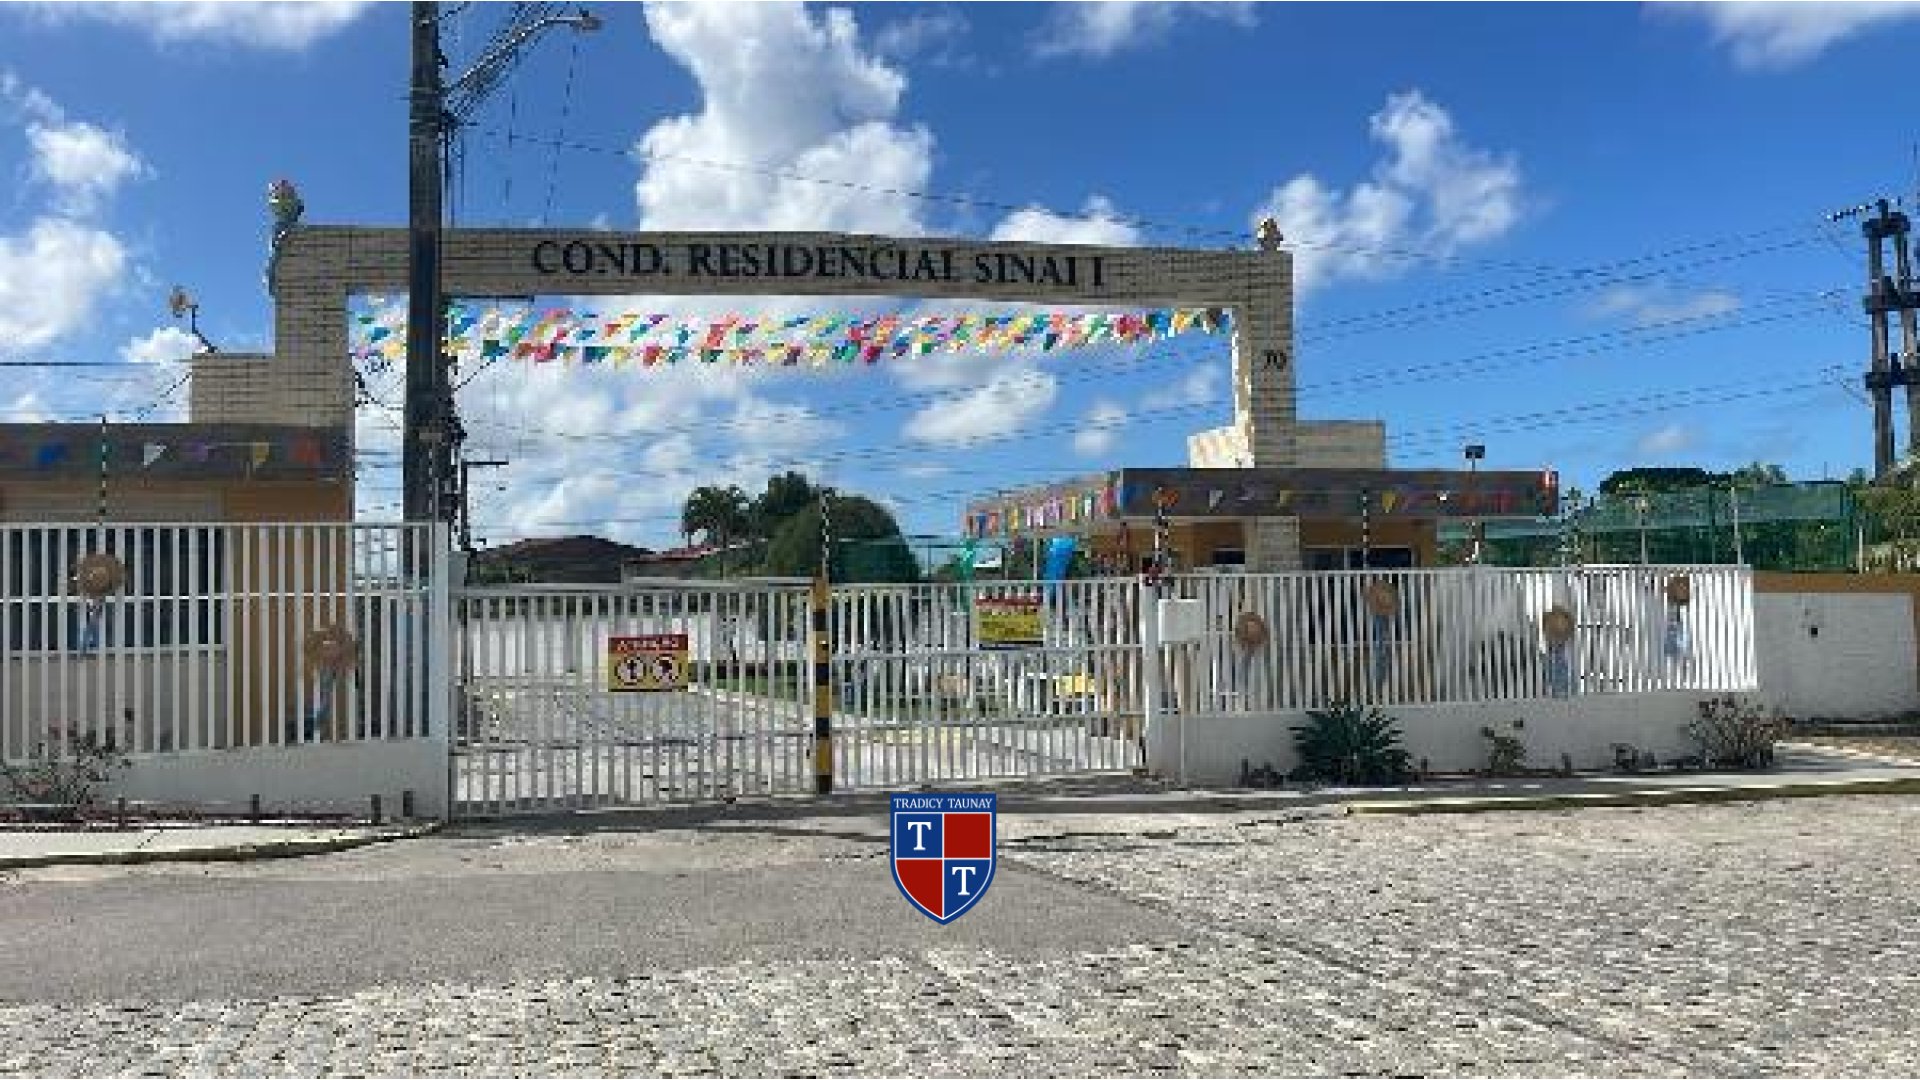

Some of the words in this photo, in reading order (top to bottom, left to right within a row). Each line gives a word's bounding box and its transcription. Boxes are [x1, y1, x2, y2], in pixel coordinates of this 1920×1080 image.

[533, 240, 671, 275] COND.
[687, 243, 953, 281] RESIDENCIAL
[975, 253, 1076, 286] SINAI
[1092, 256, 1107, 287] I
